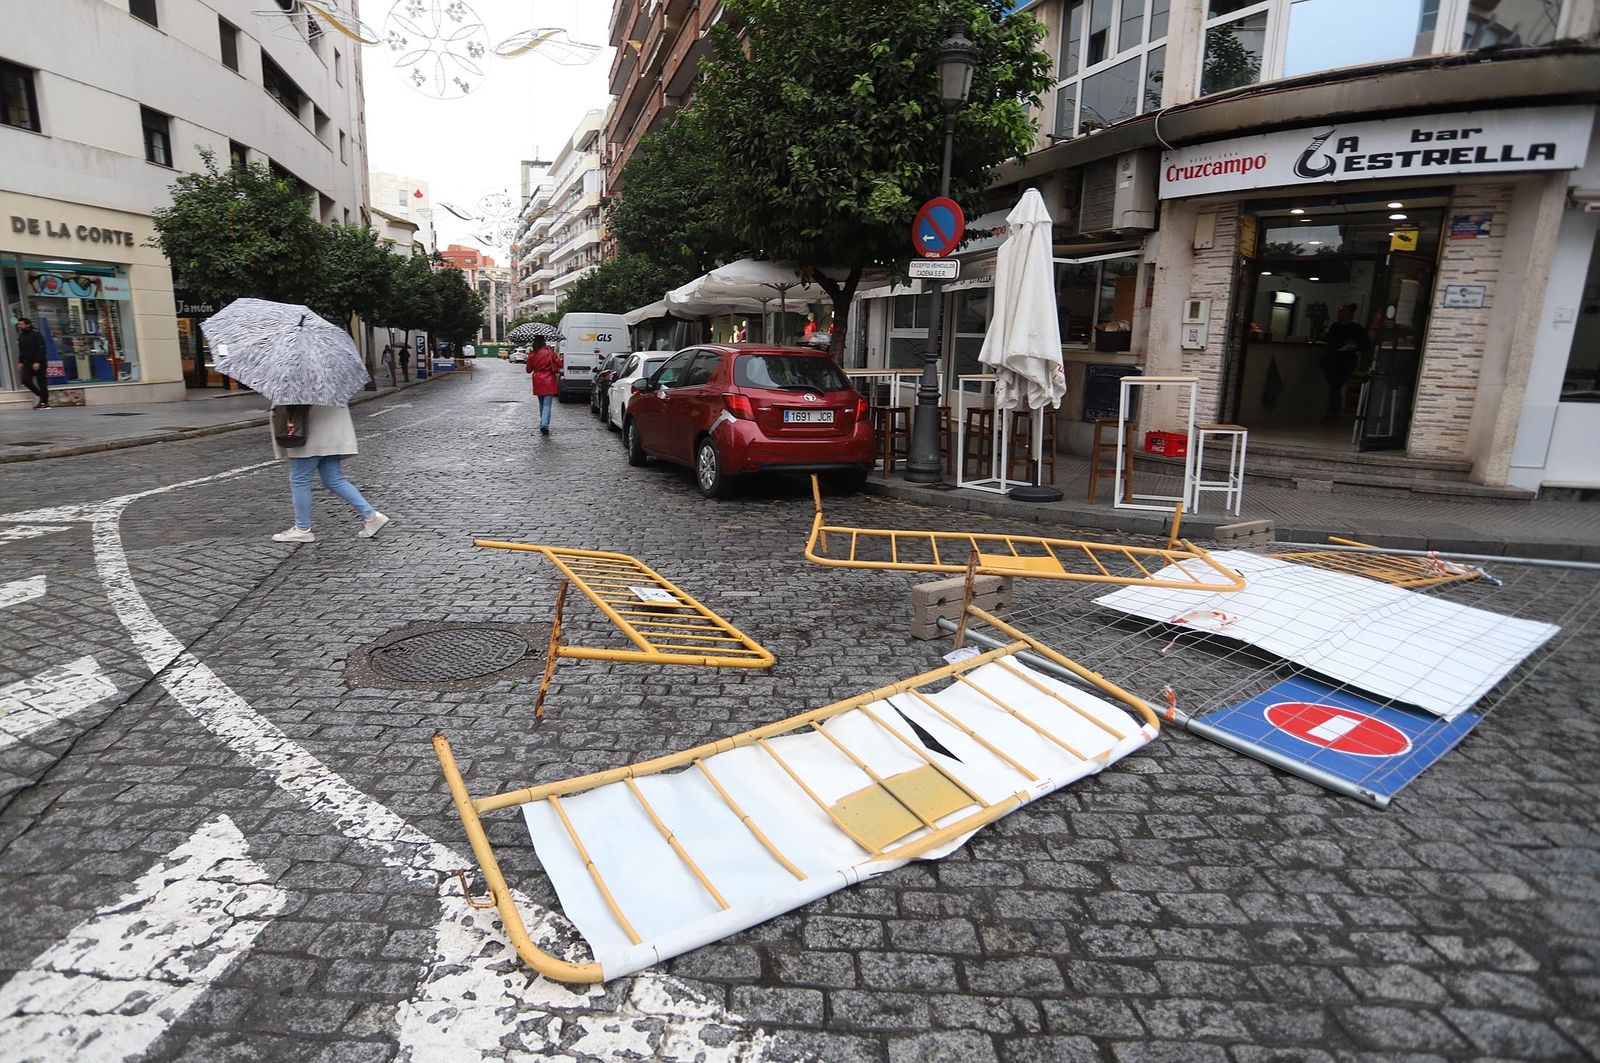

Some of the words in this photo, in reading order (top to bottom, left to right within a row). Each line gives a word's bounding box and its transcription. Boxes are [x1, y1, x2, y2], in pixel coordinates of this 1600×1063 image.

[1411, 127, 1482, 144] bar
[1344, 142, 1557, 174] ESTRELLA
[1166, 154, 1267, 182] Cruzcampo
[10, 216, 40, 235] DE
[46, 220, 71, 239] LA
[76, 225, 135, 247] CORTE
[175, 299, 214, 314] Jamón
[596, 333, 612, 342] GLS
[791, 411, 811, 421] 1691
[817, 411, 832, 422] JCR
